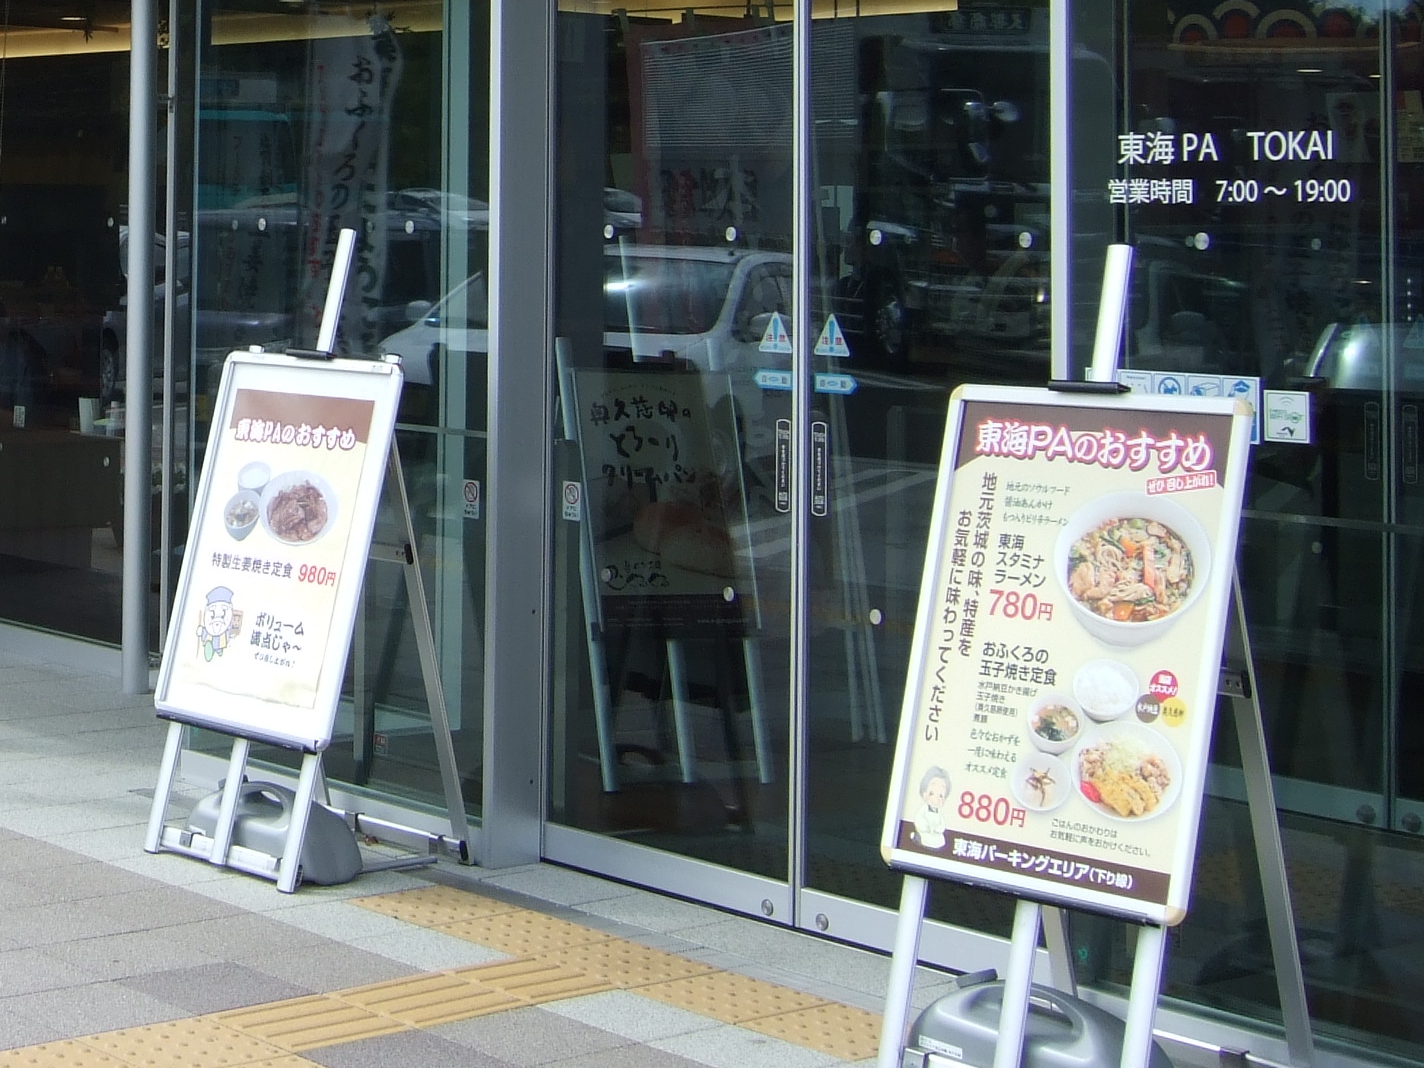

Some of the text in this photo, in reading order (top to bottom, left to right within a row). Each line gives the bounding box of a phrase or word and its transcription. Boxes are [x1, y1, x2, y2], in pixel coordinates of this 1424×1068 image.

[1117, 130, 1334, 165] 東海 PA TOKAI
[1108, 178, 1194, 205] 営業時間
[1215, 179, 1259, 203] 7:00
[1294, 178, 1351, 203] 19:00
[234, 417, 356, 450] 東海PAのおすすめ
[975, 420, 1213, 473] 東海PAのおすすめ
[998, 532, 1026, 551] 東海
[212, 552, 336, 587] 特製生姜焼き定食 980円
[959, 472, 998, 657] 地元茨城の味、特産を
[995, 551, 1045, 570] スタミナ
[994, 569, 1047, 588] ラーメン
[989, 588, 1054, 622] 780円
[255, 612, 304, 636] ボリューム
[925, 509, 973, 741] お気軽に味わってください
[982, 641, 1050, 665] おふくろの
[978, 659, 1058, 687] 玉子焼き定食
[958, 790, 1026, 828] 880円
[1052, 818, 1118, 839] ごはんのおかわりは
